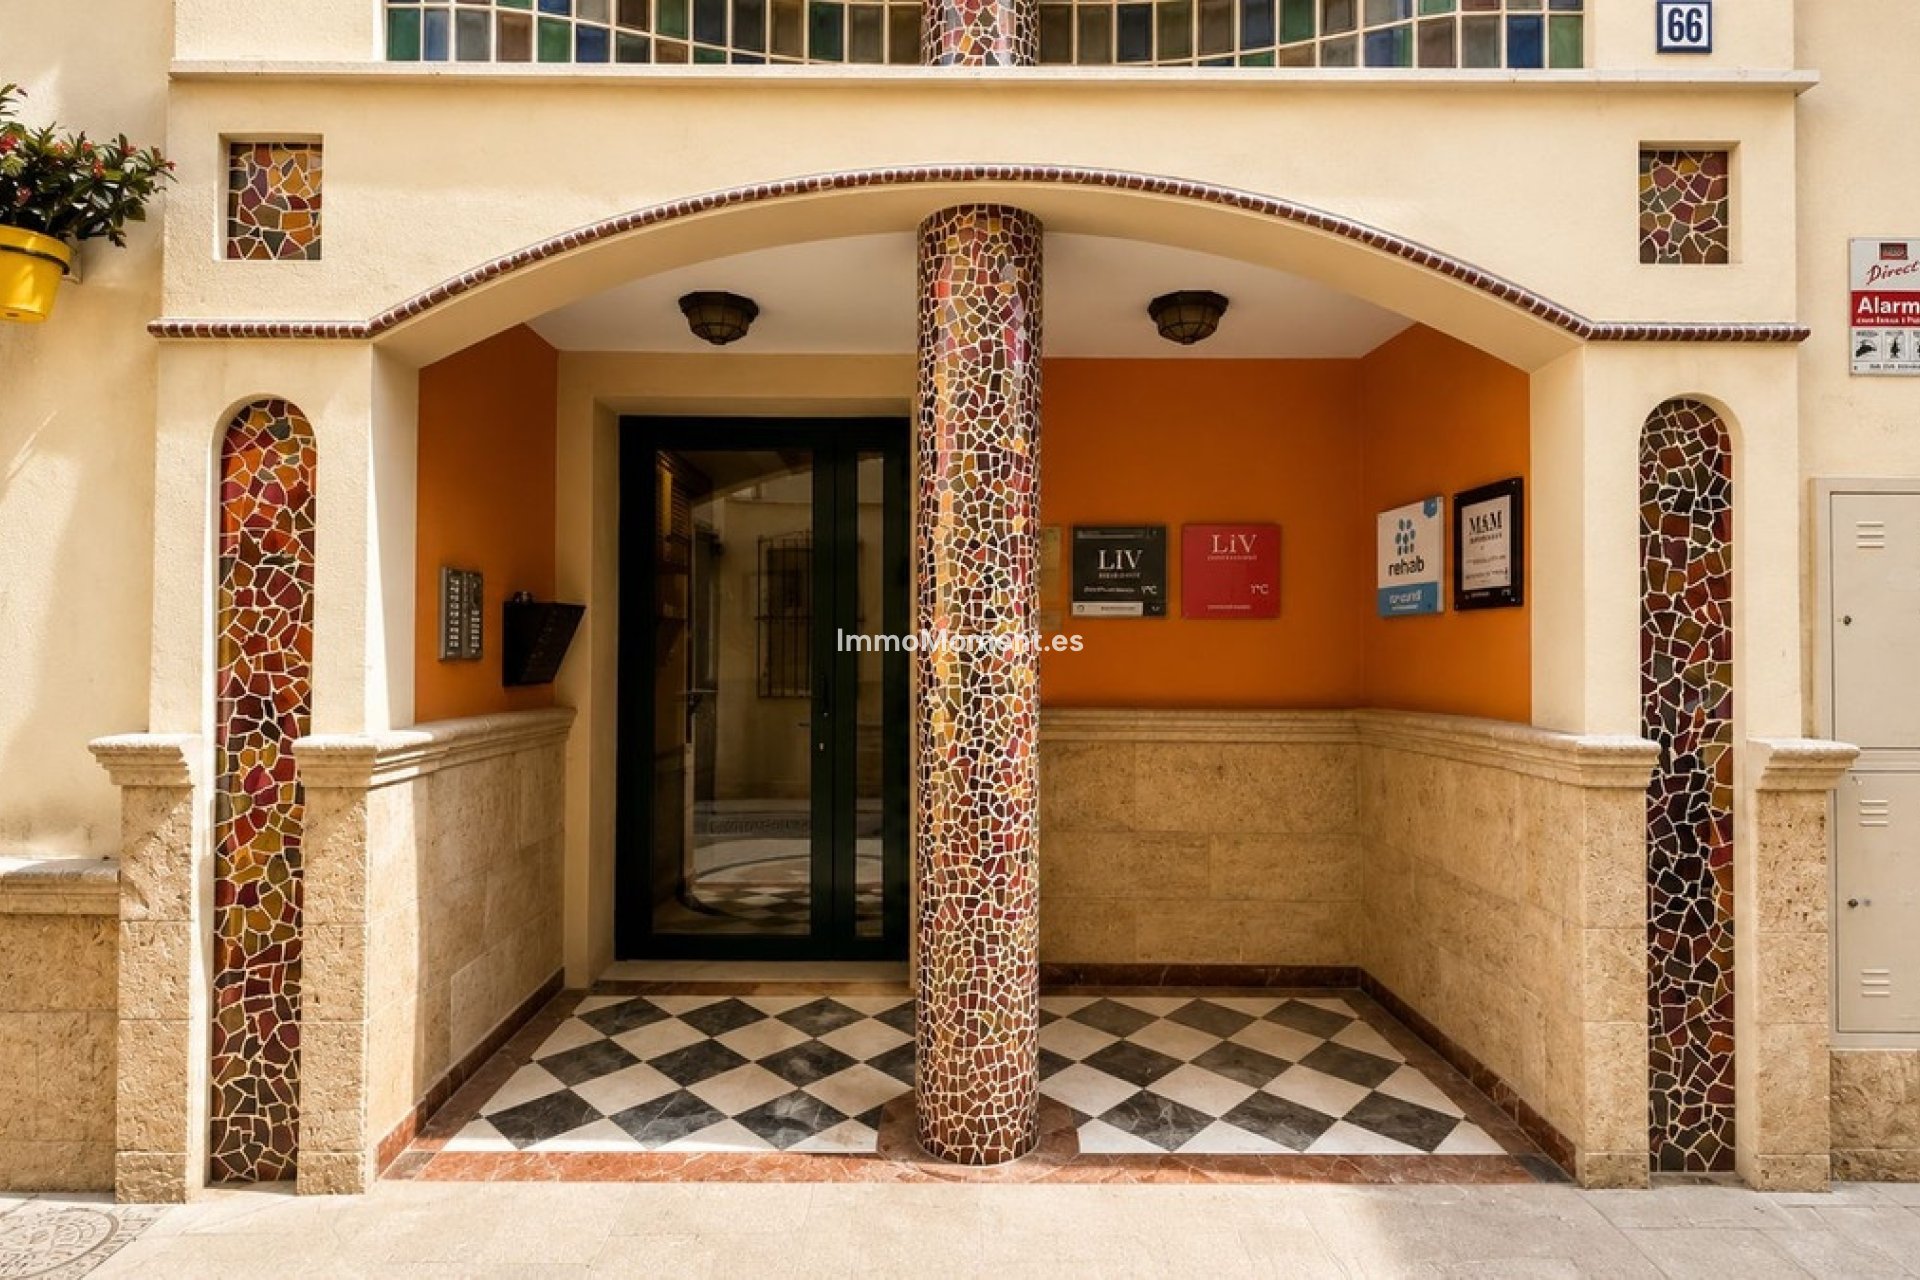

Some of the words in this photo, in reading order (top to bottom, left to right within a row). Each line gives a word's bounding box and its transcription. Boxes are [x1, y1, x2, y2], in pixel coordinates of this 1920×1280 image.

[1668, 7, 1702, 42] 66
[1866, 260, 1920, 286] Direct
[1857, 296, 1920, 314] Alarm
[1098, 549, 1143, 570] LIV
[1388, 555, 1425, 577] rehab
